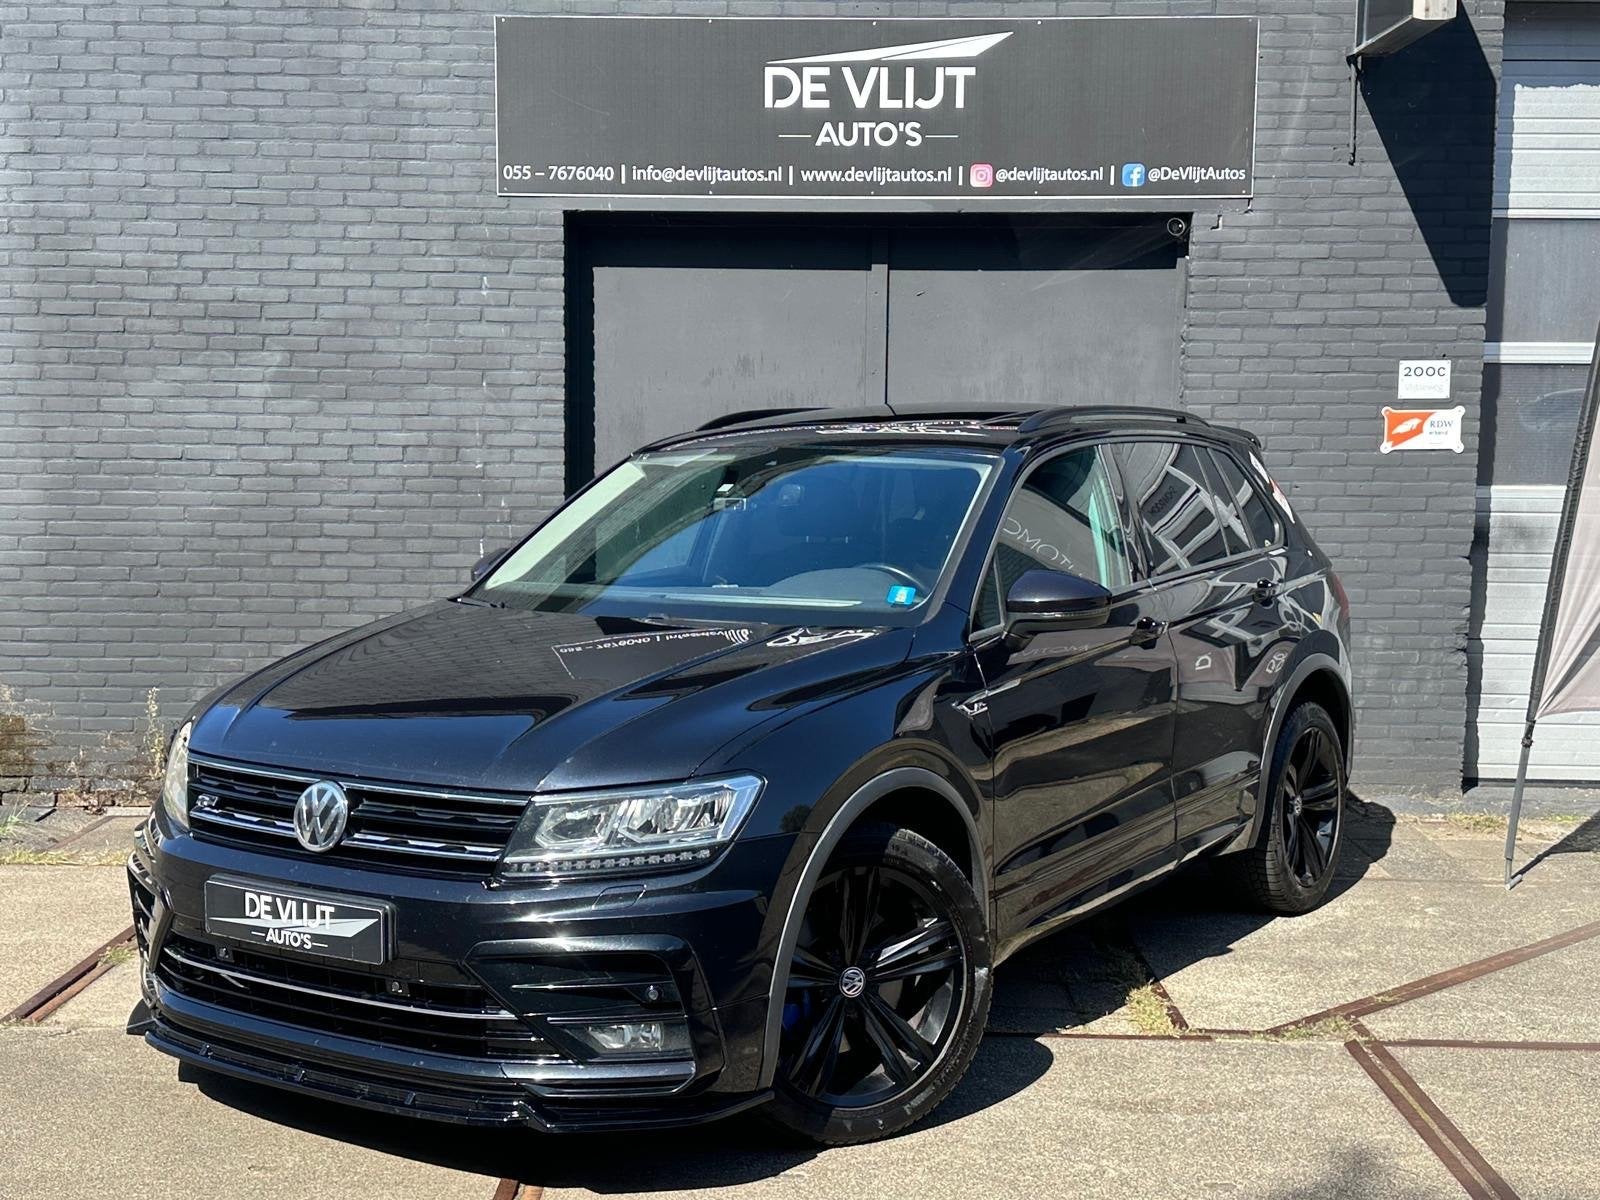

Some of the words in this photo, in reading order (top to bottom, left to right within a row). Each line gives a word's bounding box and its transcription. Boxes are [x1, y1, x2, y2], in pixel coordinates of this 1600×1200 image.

[764, 66, 831, 109] DE
[841, 66, 977, 110] VLIJT
[814, 121, 923, 147] AUTO'S
[502, 164, 532, 181] 055
[548, 165, 615, 182] 7676040
[632, 164, 782, 185] info@devlijtautos.nl
[800, 165, 952, 186] www.devlijtautos.nl
[995, 165, 1104, 185] @devlijtautos.nl
[1147, 165, 1246, 184] @DeVlijtAutos
[245, 891, 272, 920] DE
[275, 897, 335, 929] VLIJT
[265, 928, 312, 950] AUTO'S
